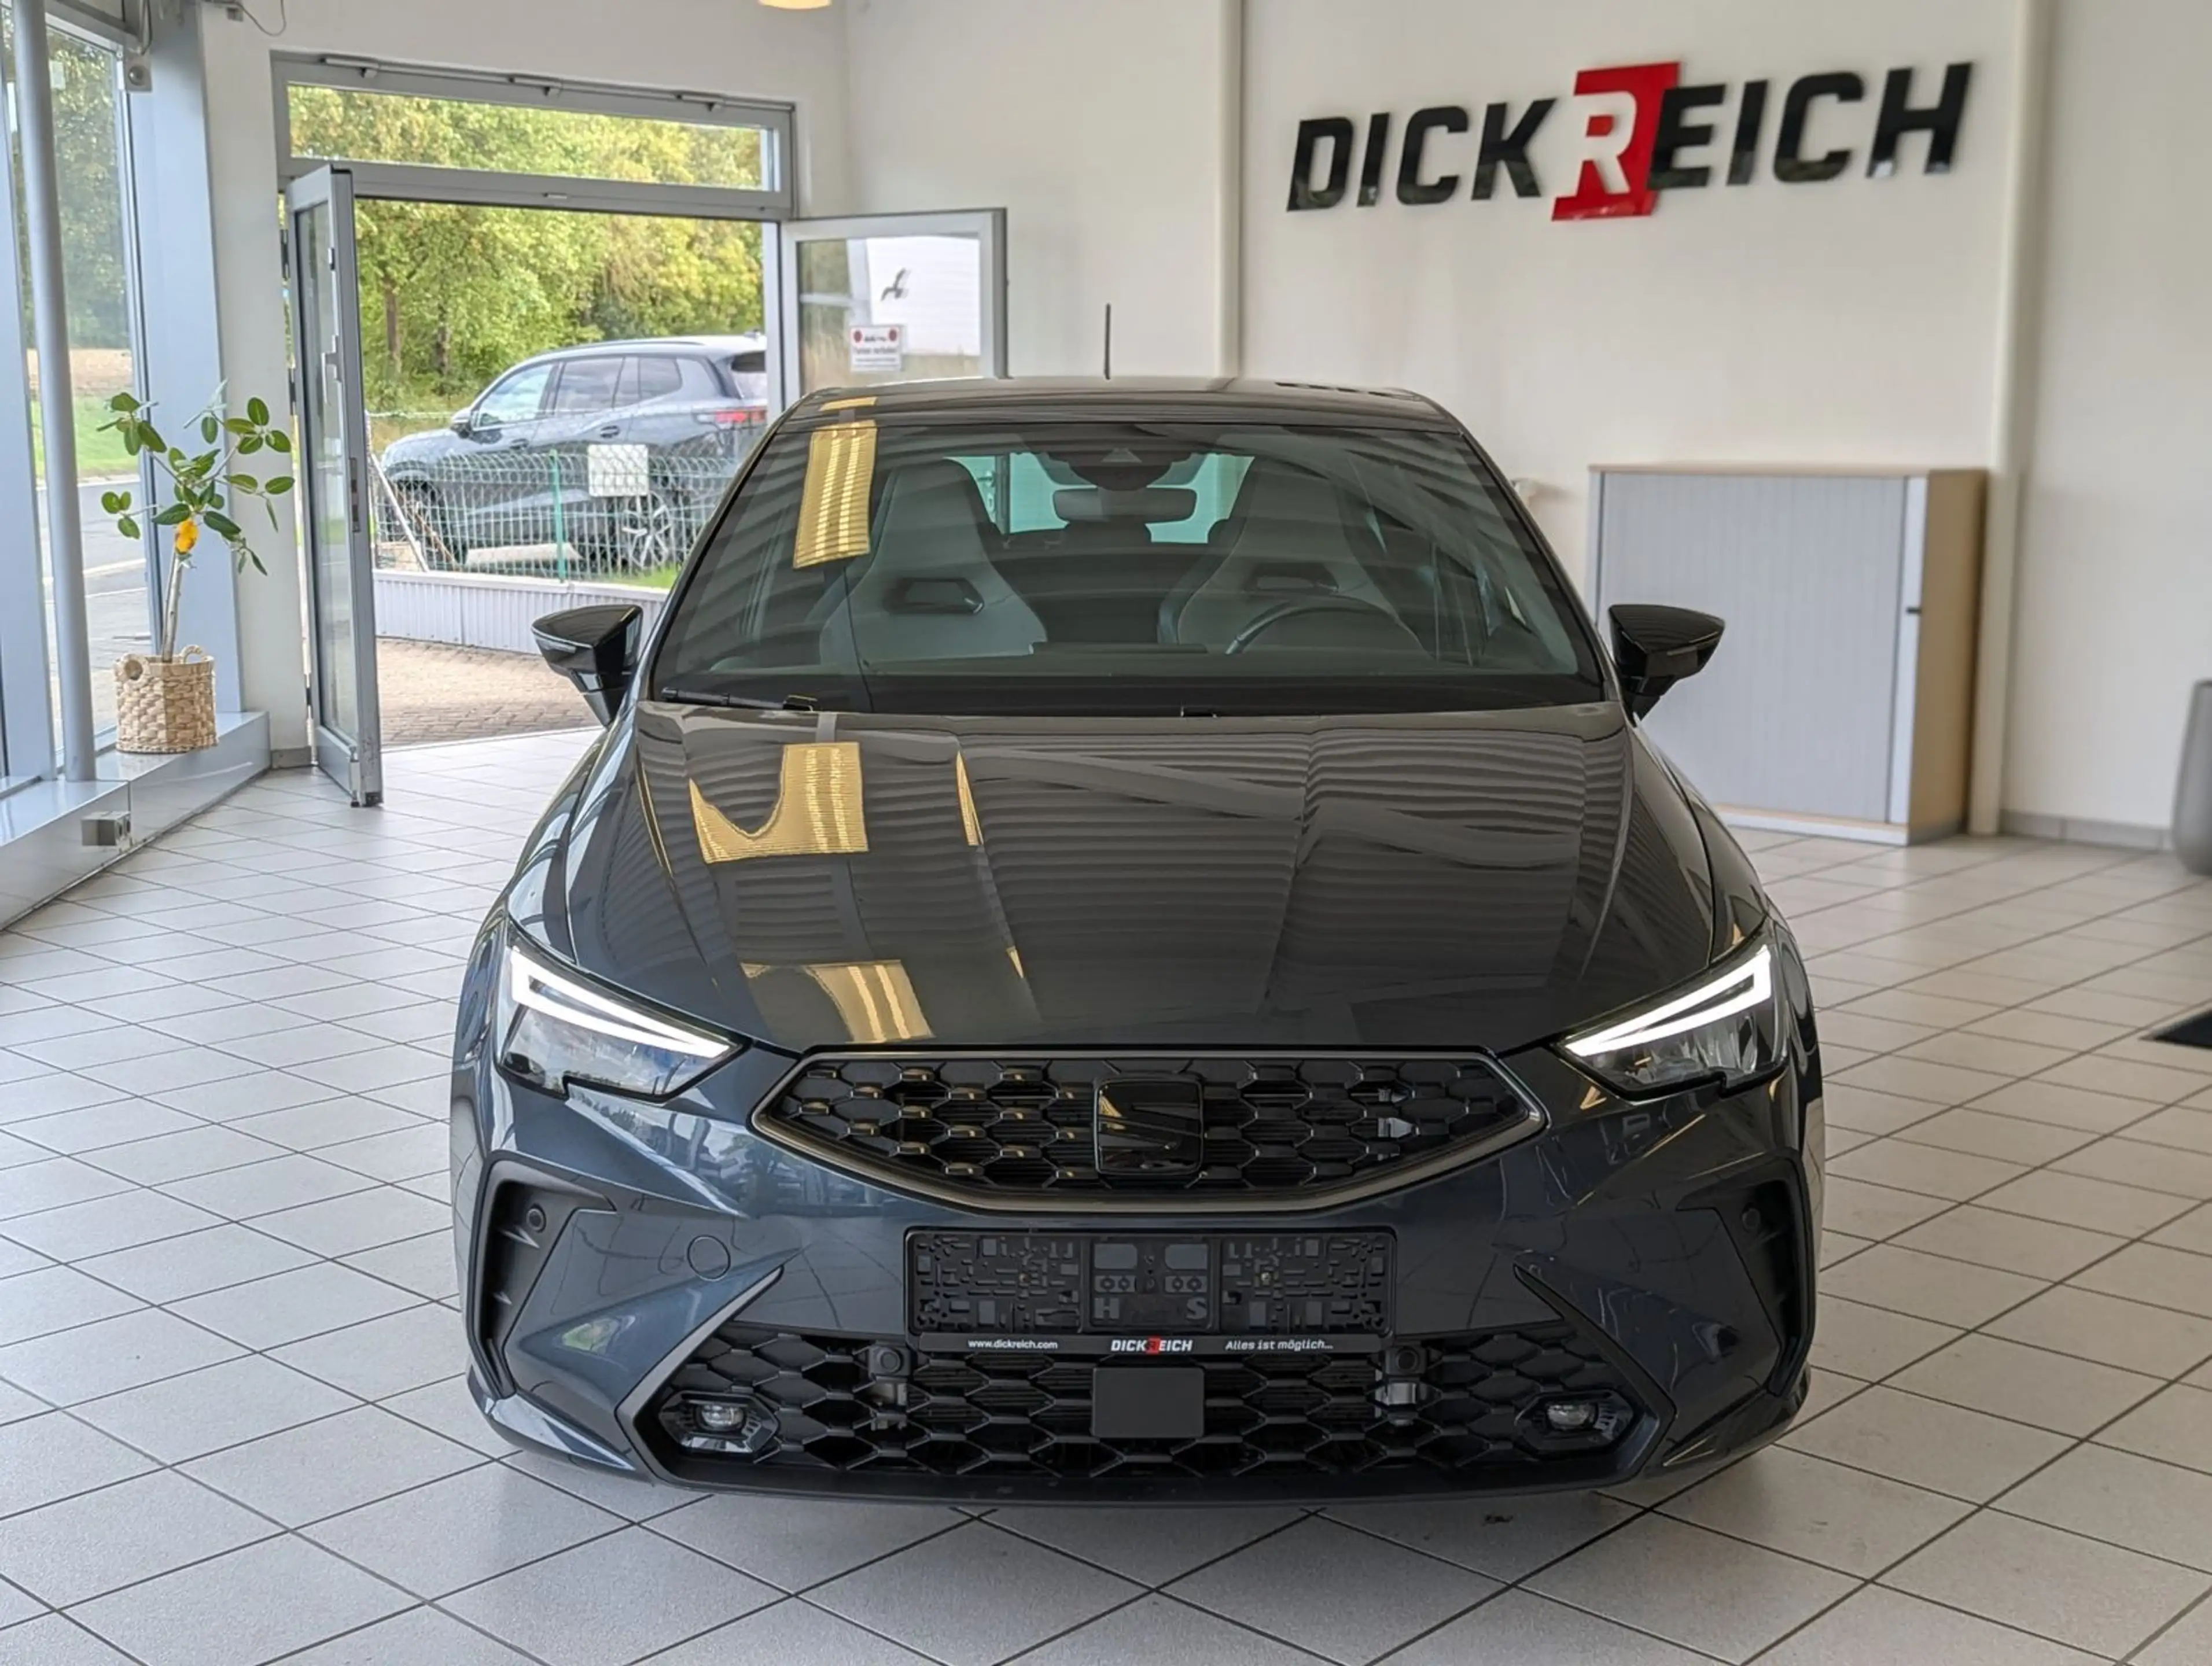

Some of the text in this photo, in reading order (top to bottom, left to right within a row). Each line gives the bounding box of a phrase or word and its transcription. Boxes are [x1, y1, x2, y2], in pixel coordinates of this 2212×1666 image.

[1286, 61, 1972, 222] DICKREICH
[967, 1338, 1058, 1350] www.dickreich.com
[1225, 1338, 1334, 1352] Alles ist möglich...
